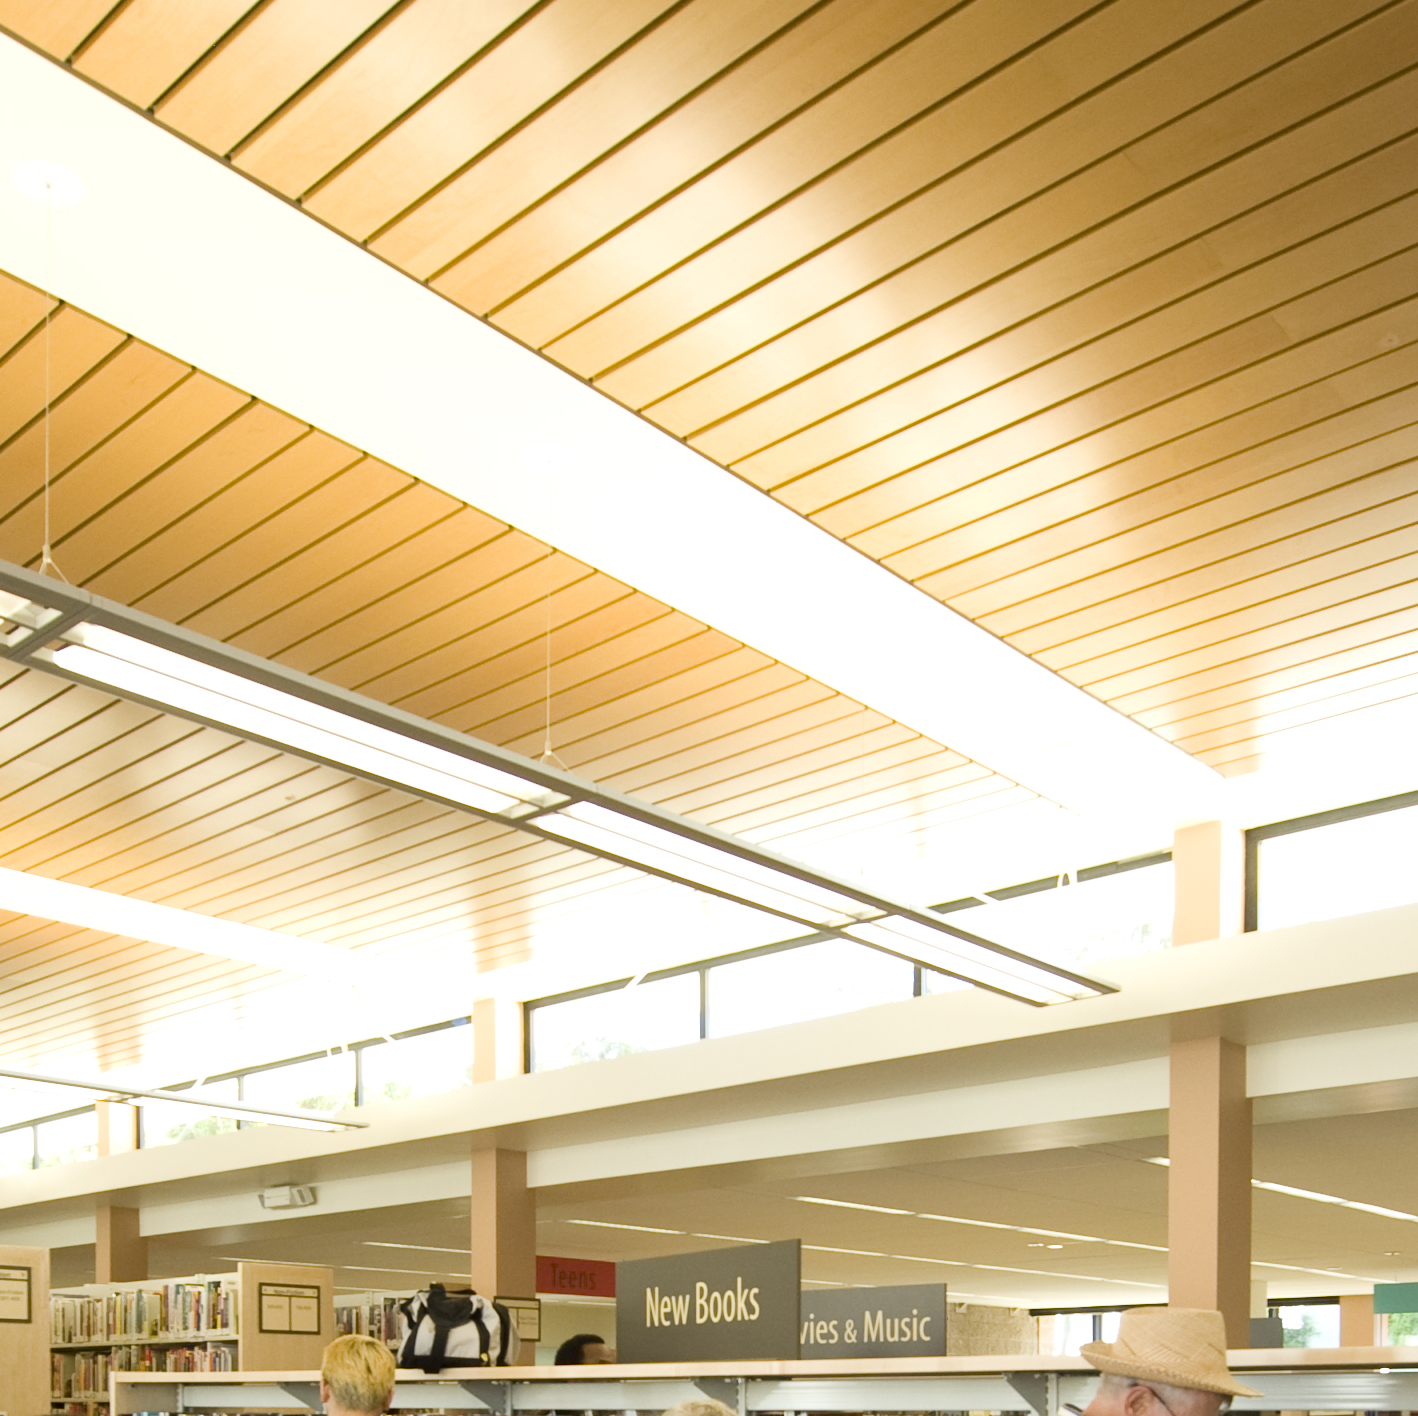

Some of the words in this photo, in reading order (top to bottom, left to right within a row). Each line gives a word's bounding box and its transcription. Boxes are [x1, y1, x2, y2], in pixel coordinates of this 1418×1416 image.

[550, 1264, 596, 1290] Teens
[645, 1286, 690, 1328] New
[694, 1276, 760, 1325] Books
[800, 1313, 838, 1345] vies
[843, 1319, 857, 1343] &
[863, 1308, 931, 1344] Music
